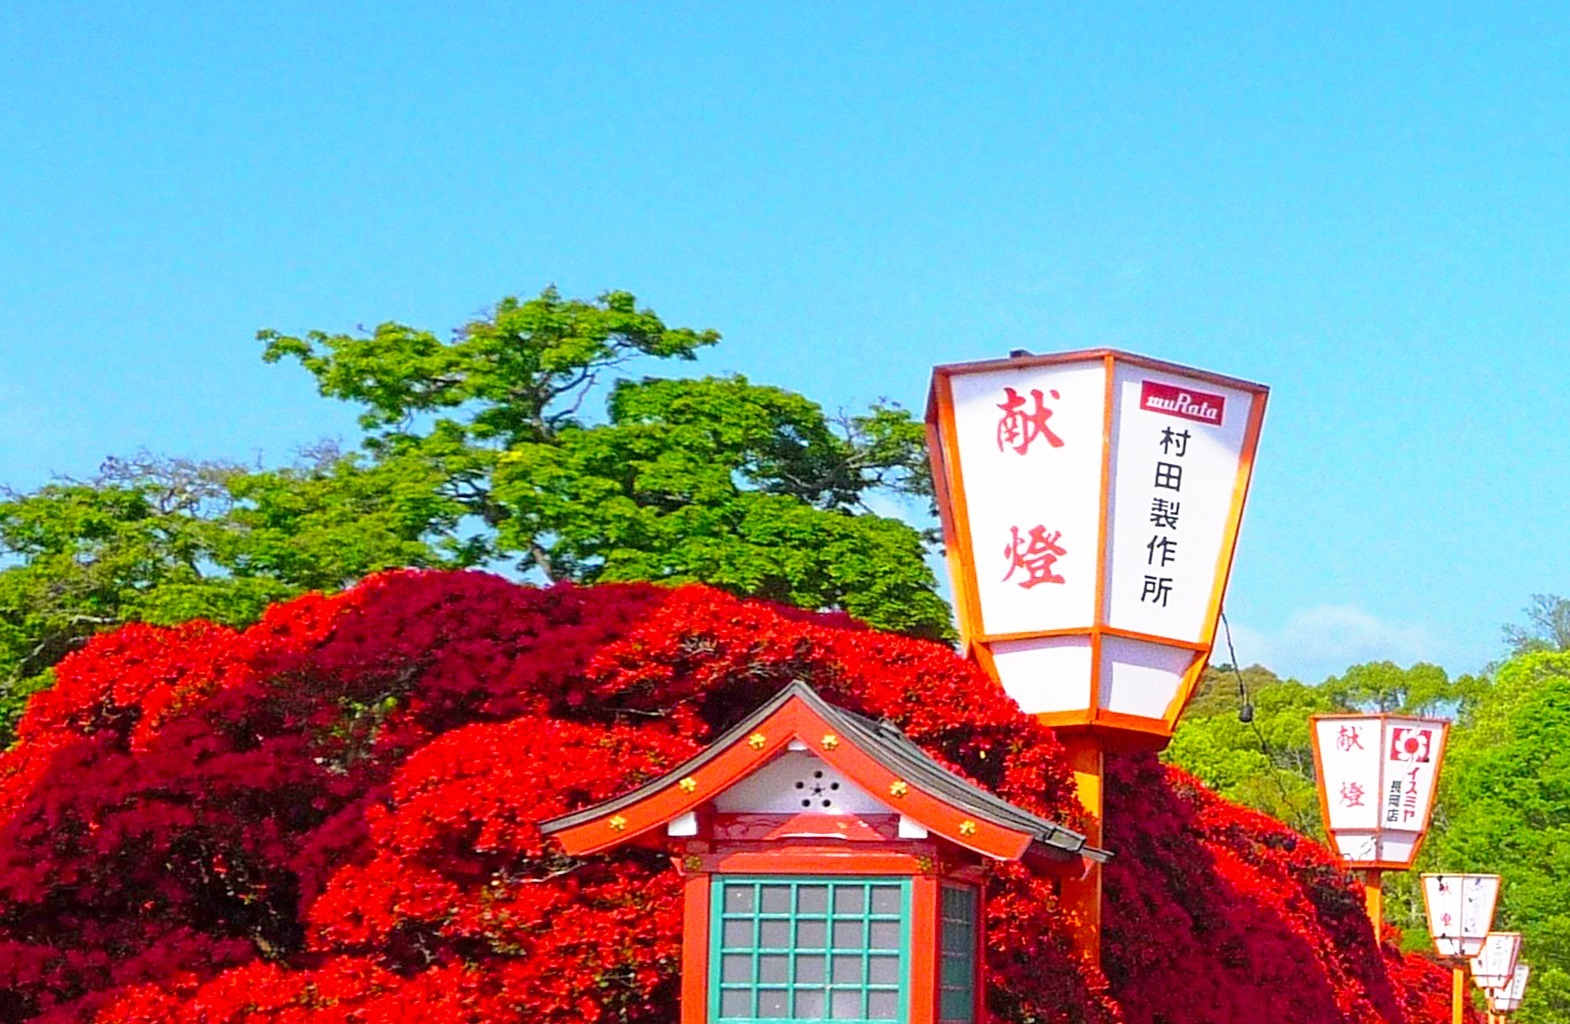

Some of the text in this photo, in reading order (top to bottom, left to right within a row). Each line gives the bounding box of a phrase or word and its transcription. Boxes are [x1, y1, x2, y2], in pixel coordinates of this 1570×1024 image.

[996, 386, 1068, 590] 献燈
[1146, 392, 1219, 421] muRata
[1140, 426, 1191, 607] 村田製作所
